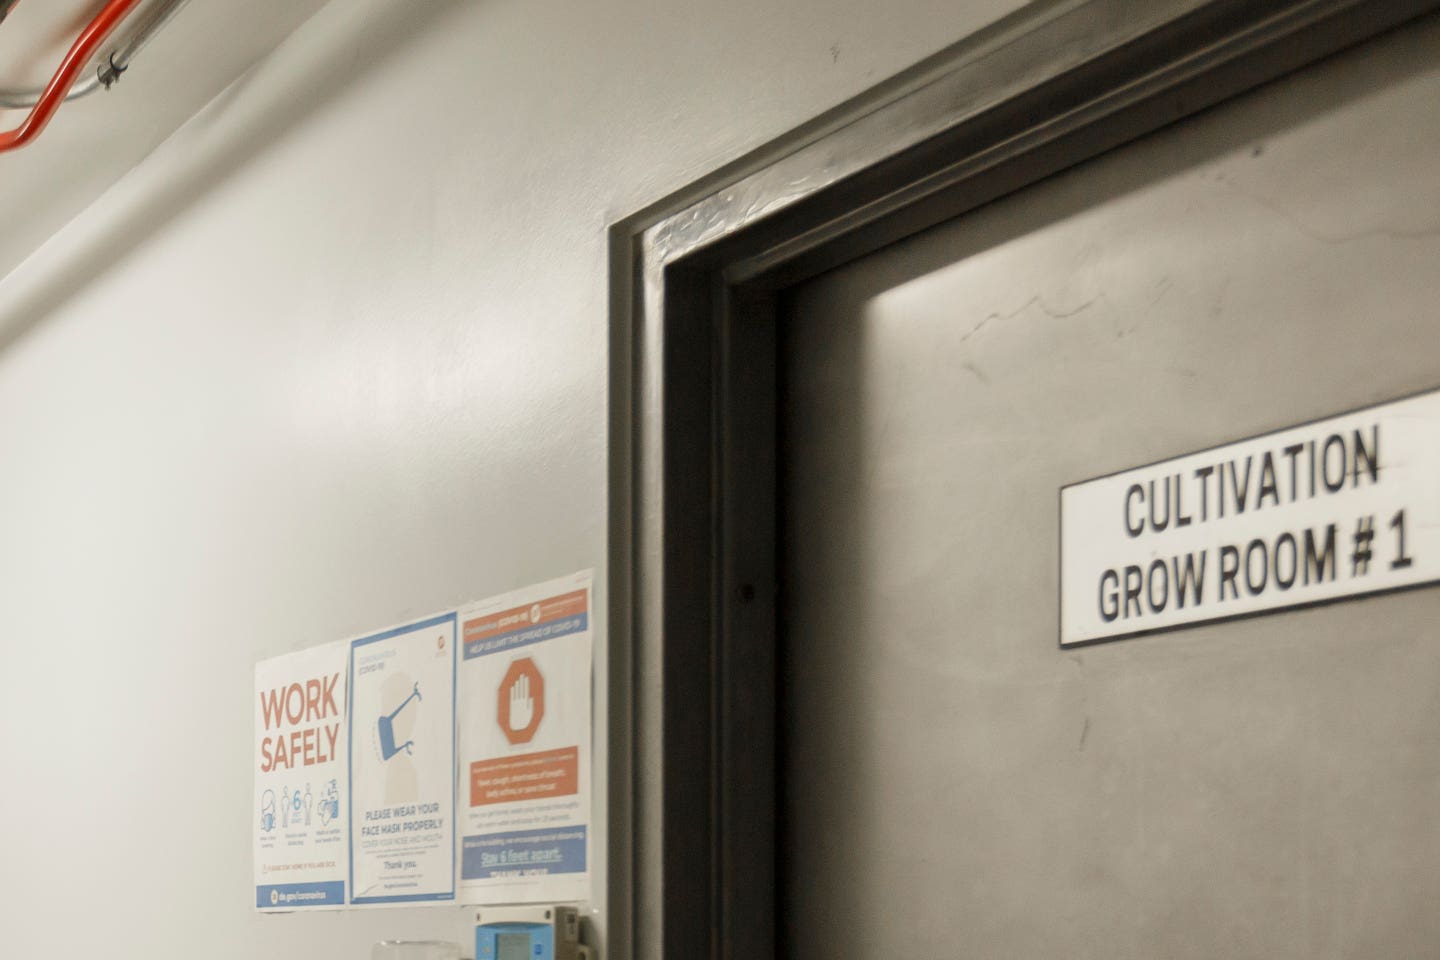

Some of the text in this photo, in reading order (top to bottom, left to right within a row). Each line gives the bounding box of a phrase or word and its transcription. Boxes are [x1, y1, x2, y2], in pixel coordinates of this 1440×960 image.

[1123, 423, 1379, 538] CULTIVATION
[1098, 549, 1207, 623] GROW
[1218, 523, 1336, 602] ROOM
[260, 672, 339, 730] WORK
[261, 723, 339, 772] SAFELY
[361, 819, 443, 836] FACE MASK PROPERLY
[365, 803, 439, 821] PLEASE WEAR YOUR
